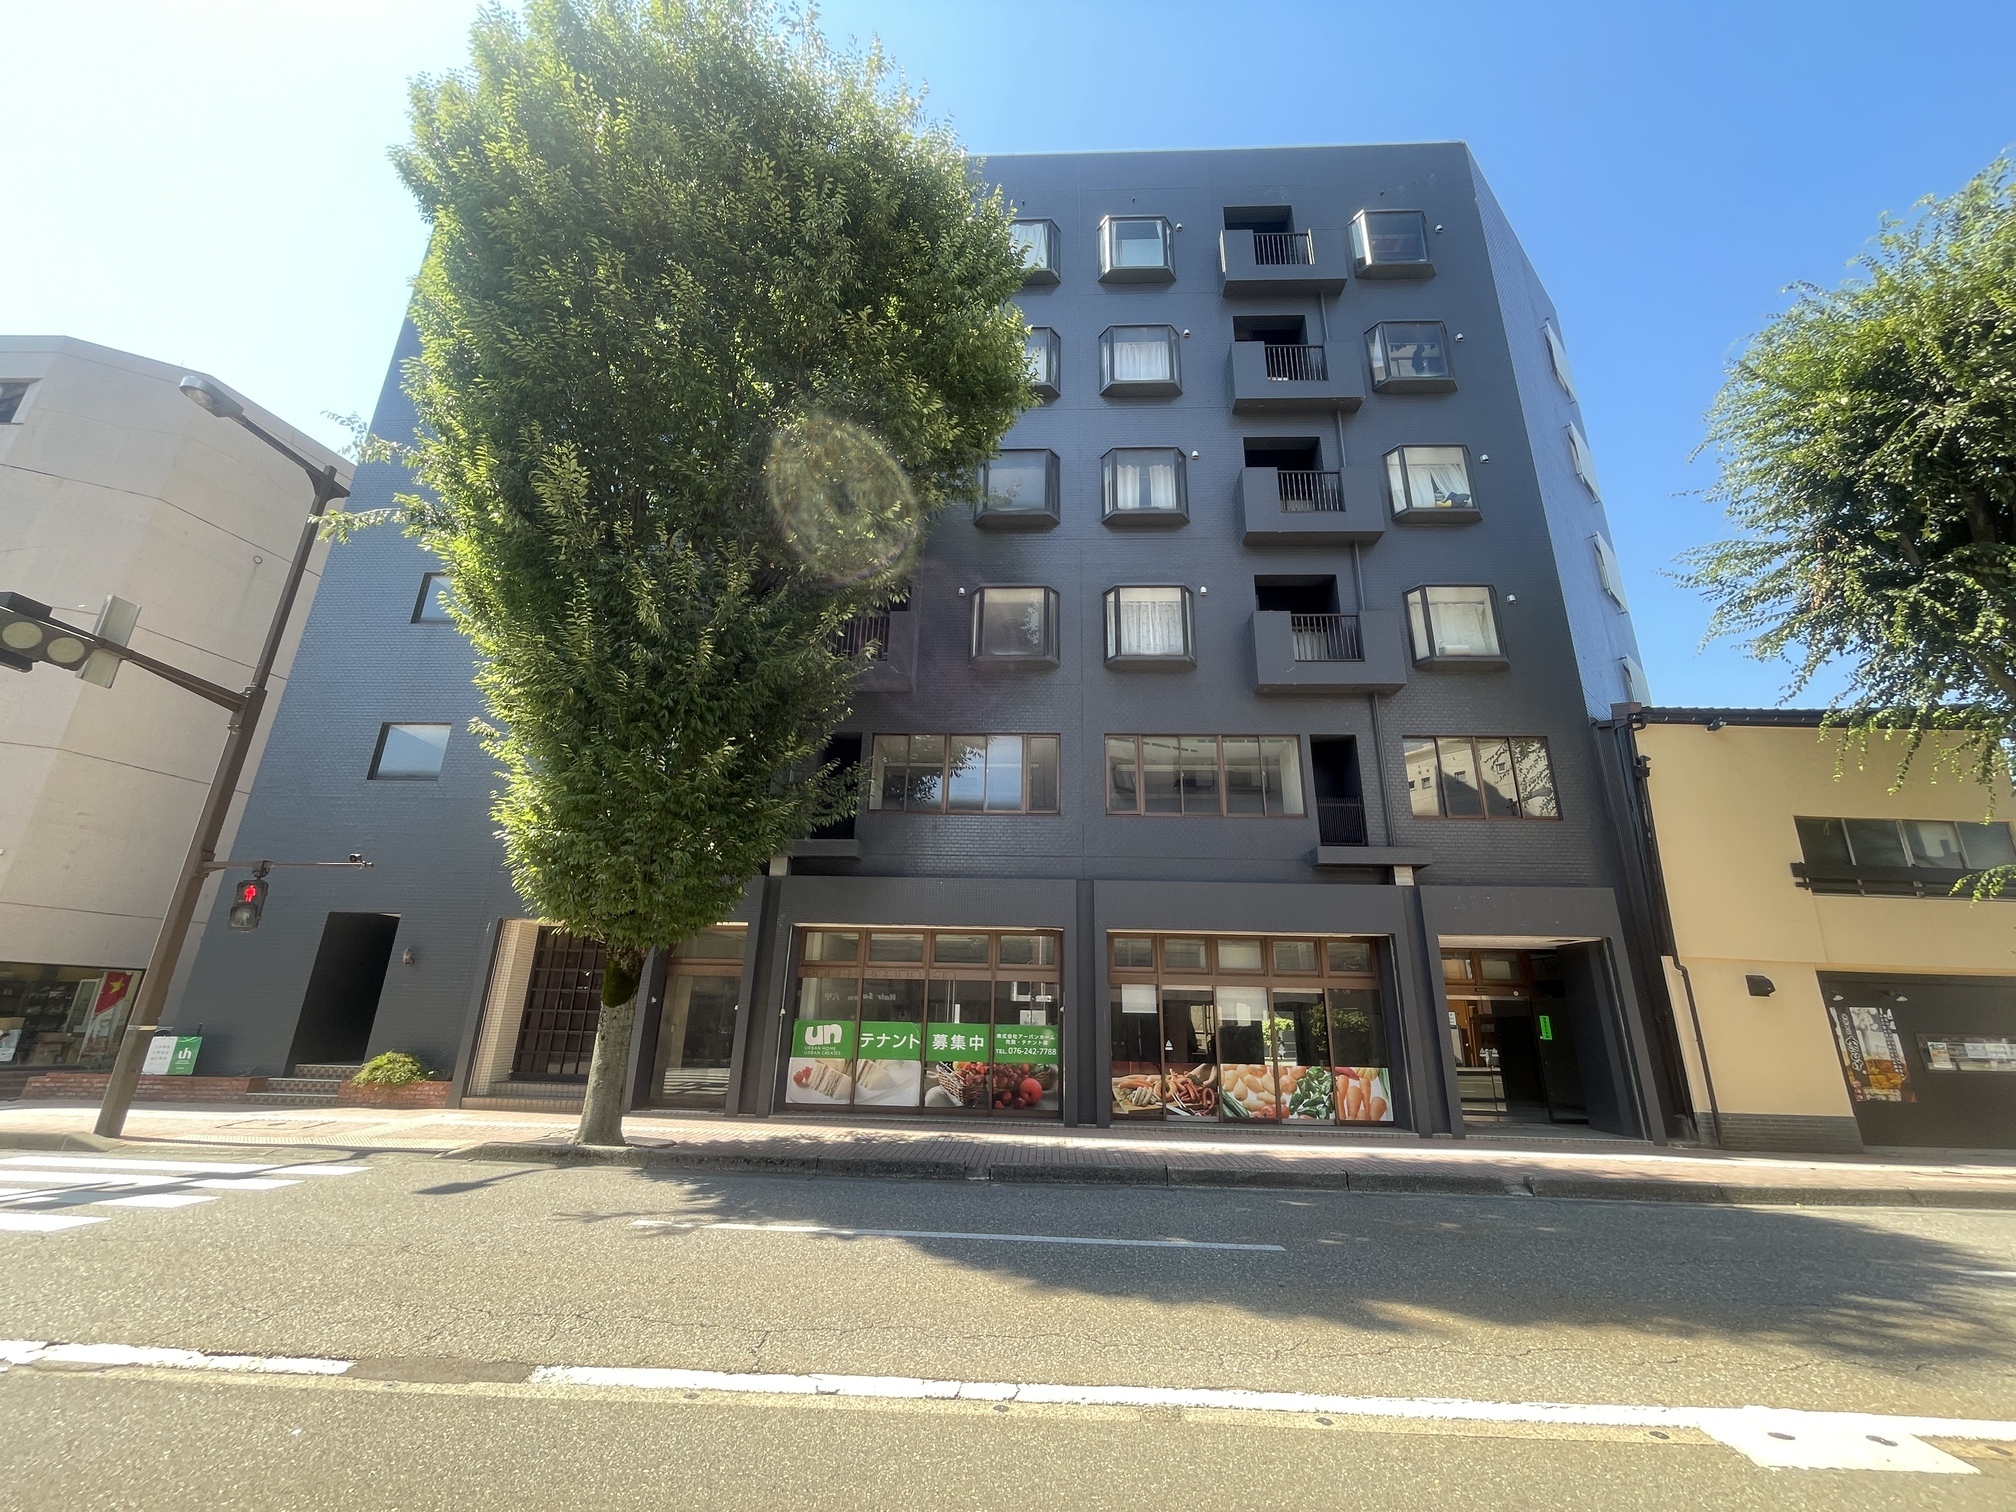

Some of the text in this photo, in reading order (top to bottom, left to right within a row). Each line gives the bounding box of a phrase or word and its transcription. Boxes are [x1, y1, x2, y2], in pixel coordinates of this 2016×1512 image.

[860, 1033, 984, 1051] テナント 募集中
[1008, 1047, 1057, 1055] 076-242-7788
